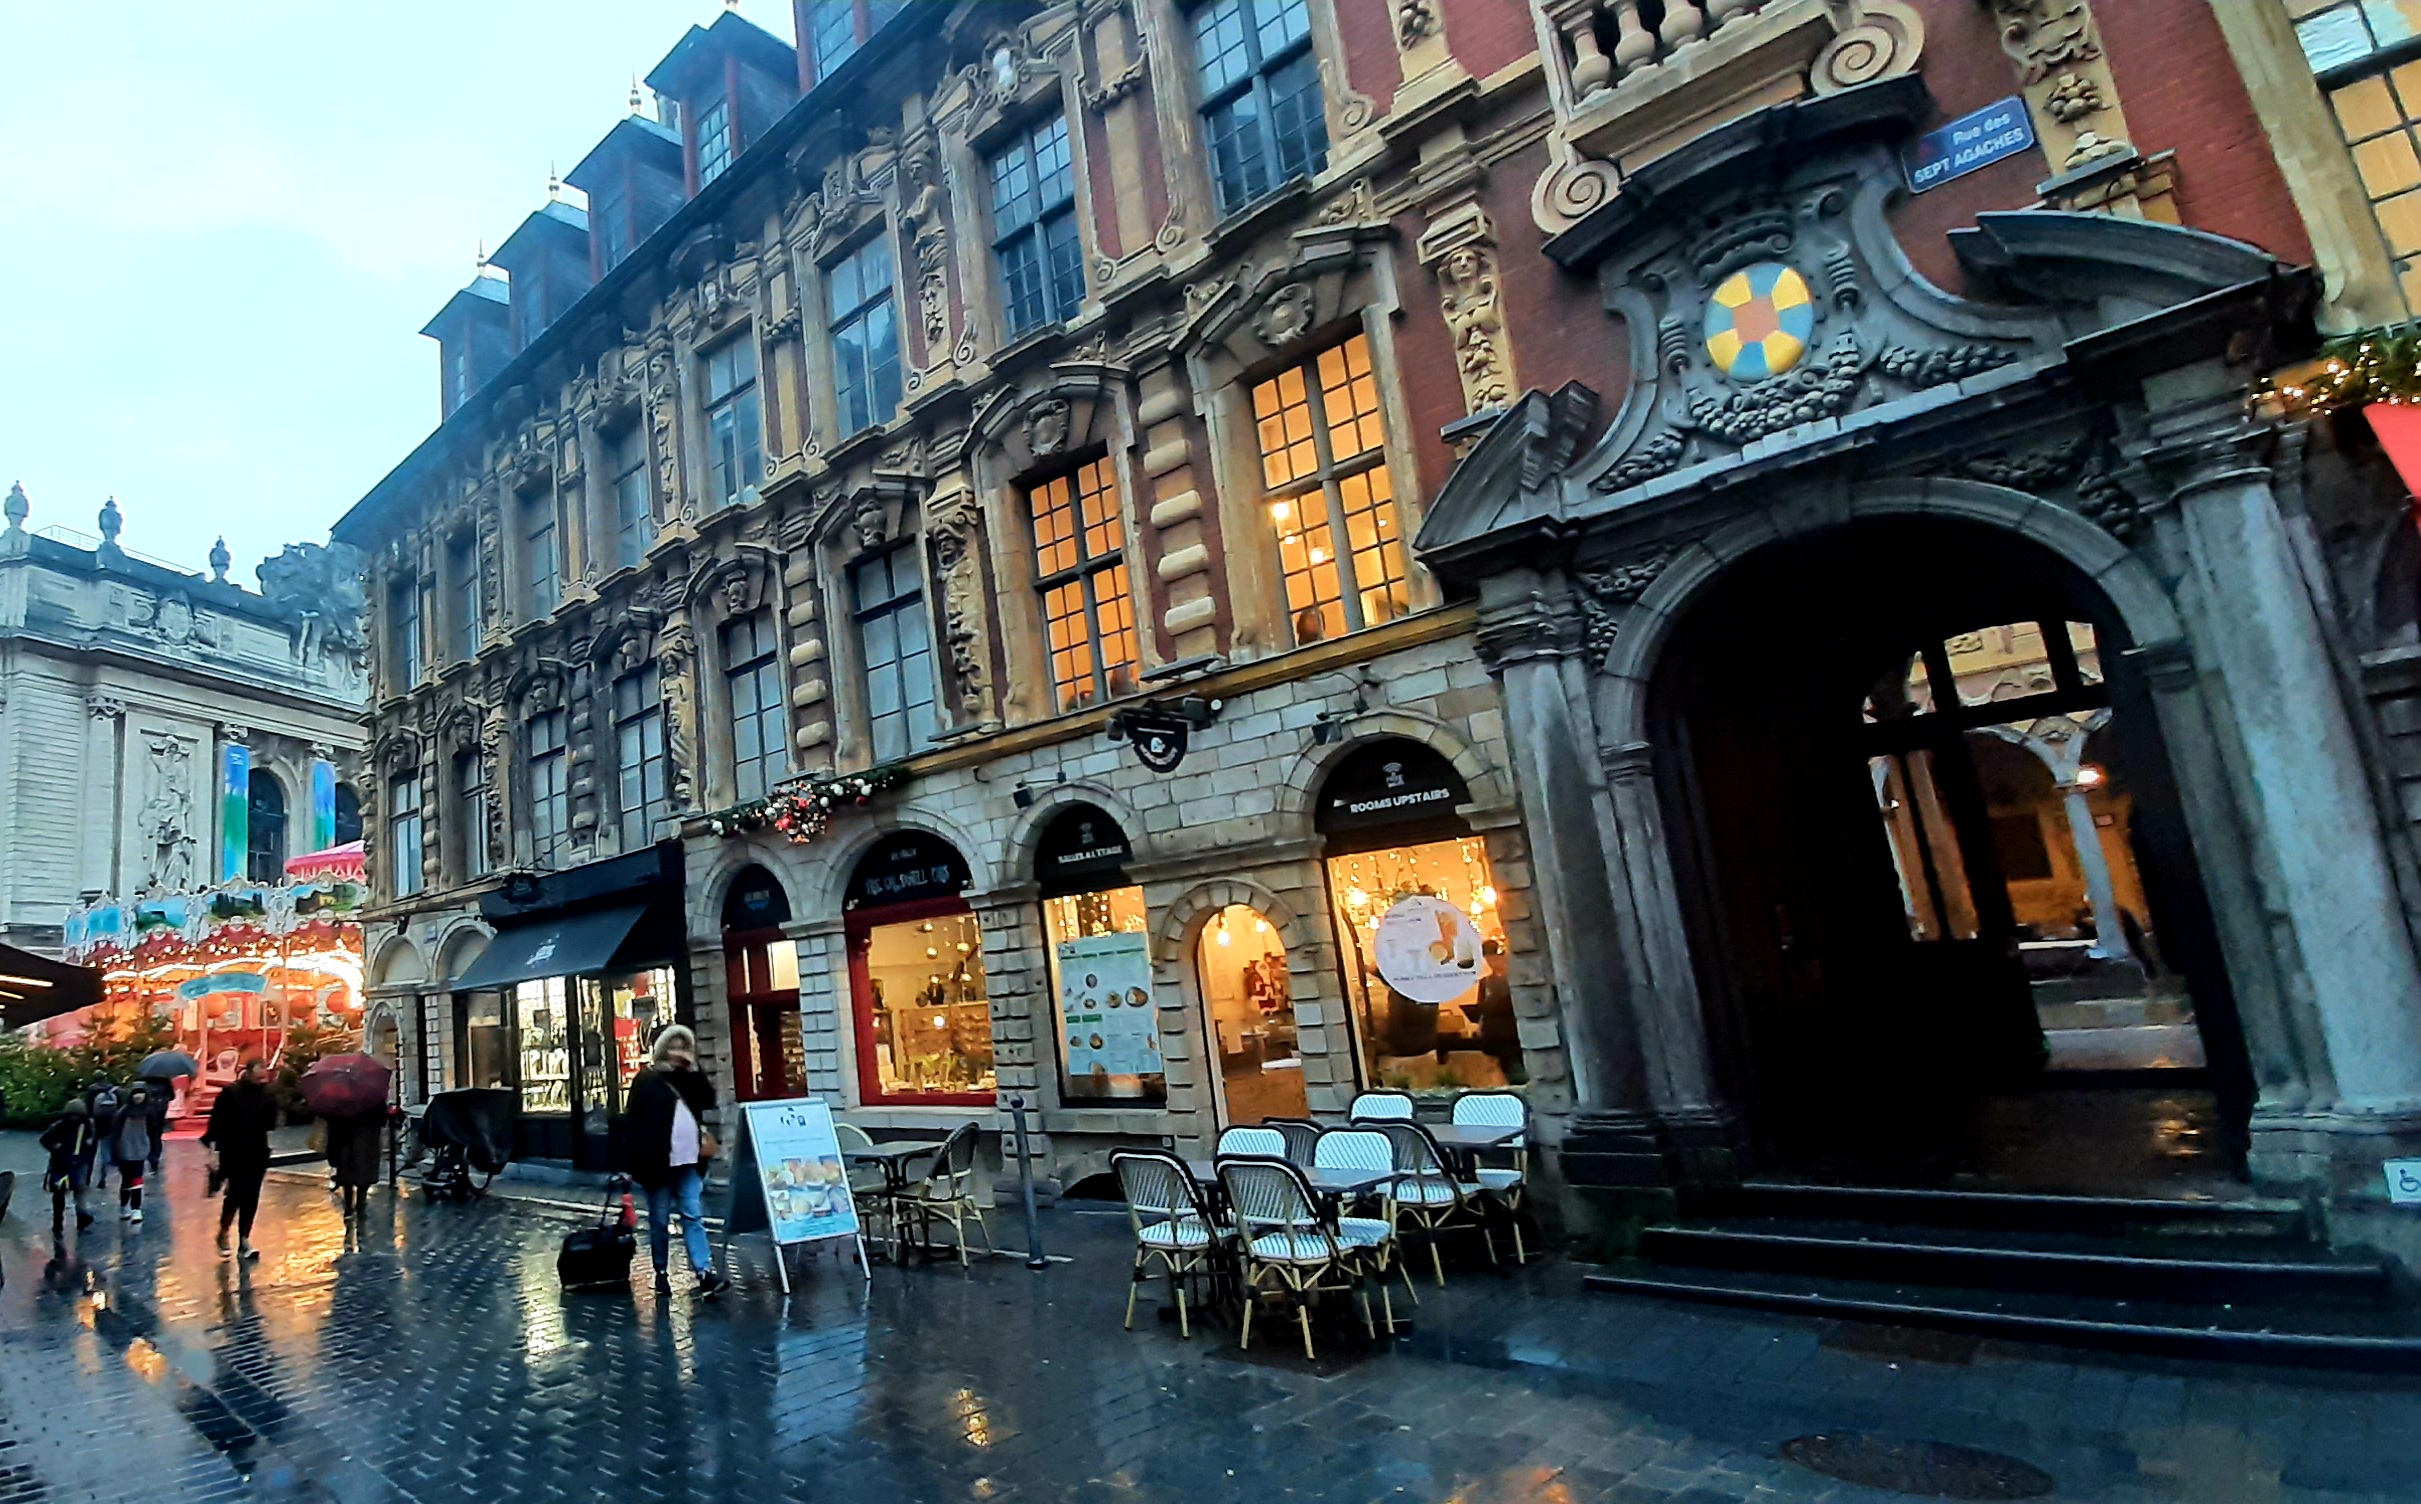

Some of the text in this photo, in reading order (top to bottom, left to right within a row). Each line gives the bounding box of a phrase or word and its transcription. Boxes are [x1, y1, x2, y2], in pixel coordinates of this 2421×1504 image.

[1953, 113, 2011, 145] Rue des
[1914, 127, 2025, 183] SEPT AGACHES
[1350, 788, 1450, 813] ROOMS UPSTAIRS
